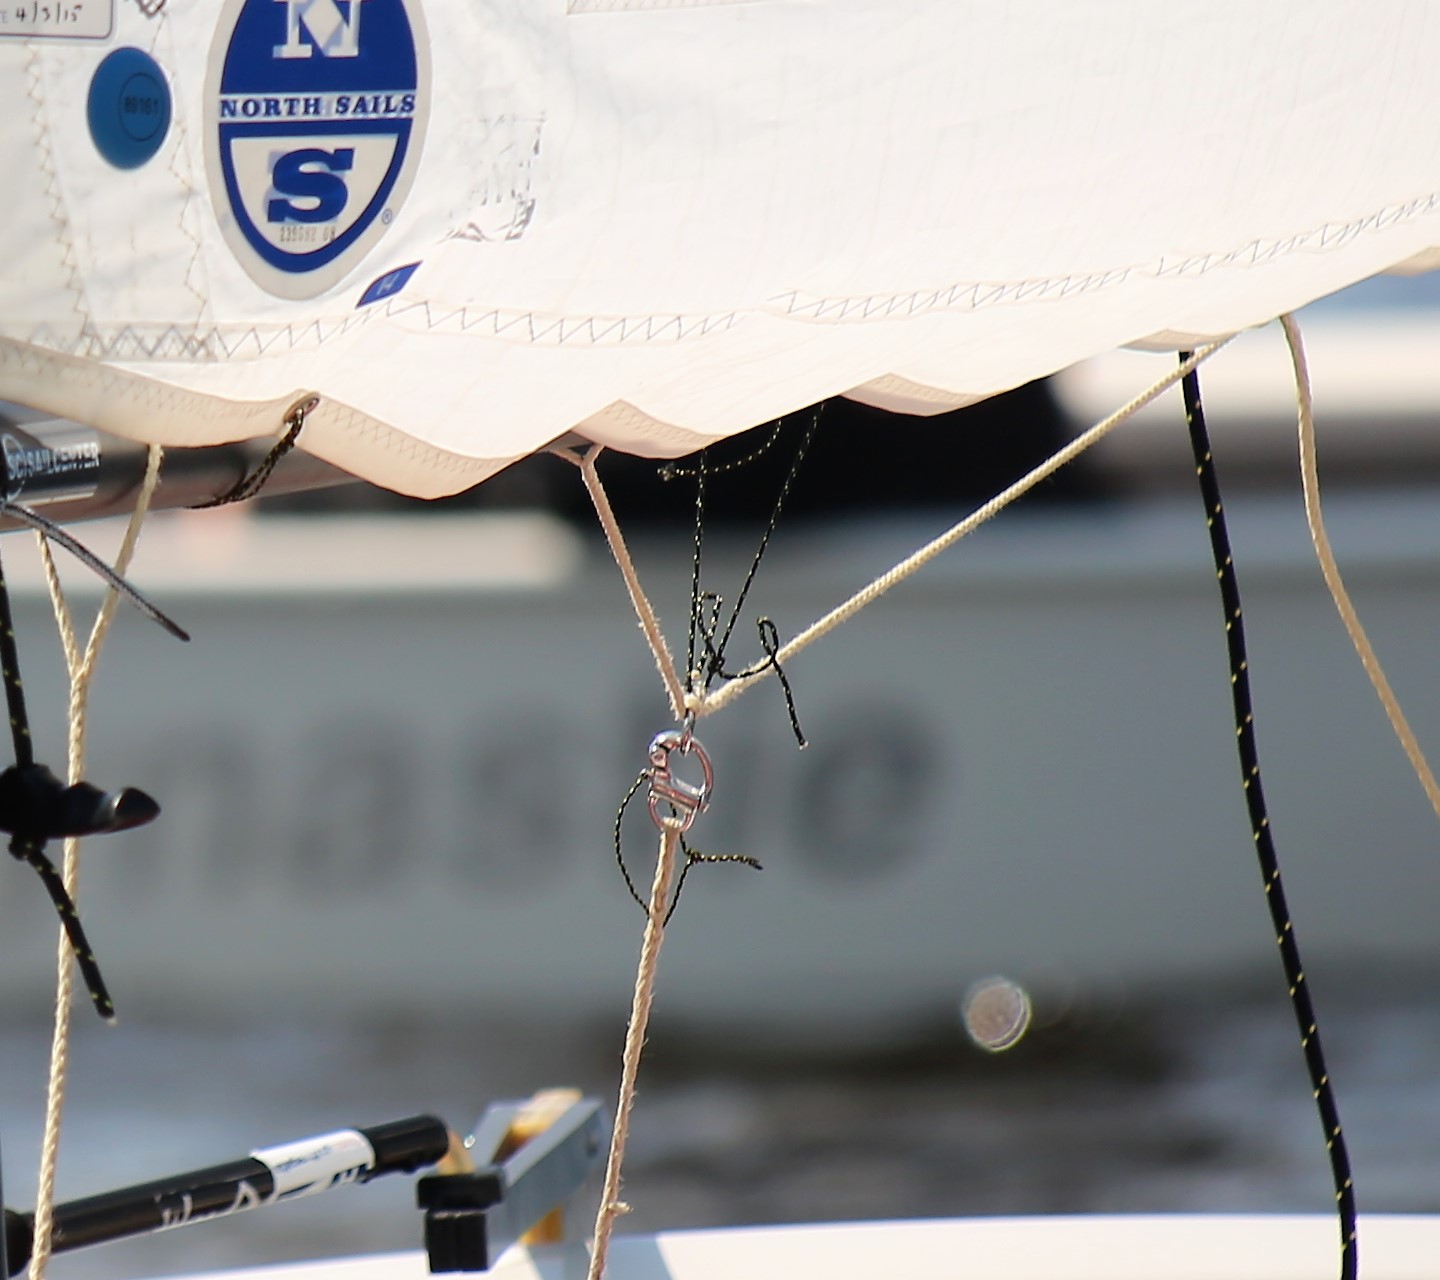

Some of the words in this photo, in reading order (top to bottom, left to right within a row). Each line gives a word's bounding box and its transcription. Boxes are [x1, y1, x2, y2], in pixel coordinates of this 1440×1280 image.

[220, 96, 321, 118] NORTH
[335, 93, 416, 115] SAILS
[267, 147, 356, 223] S
